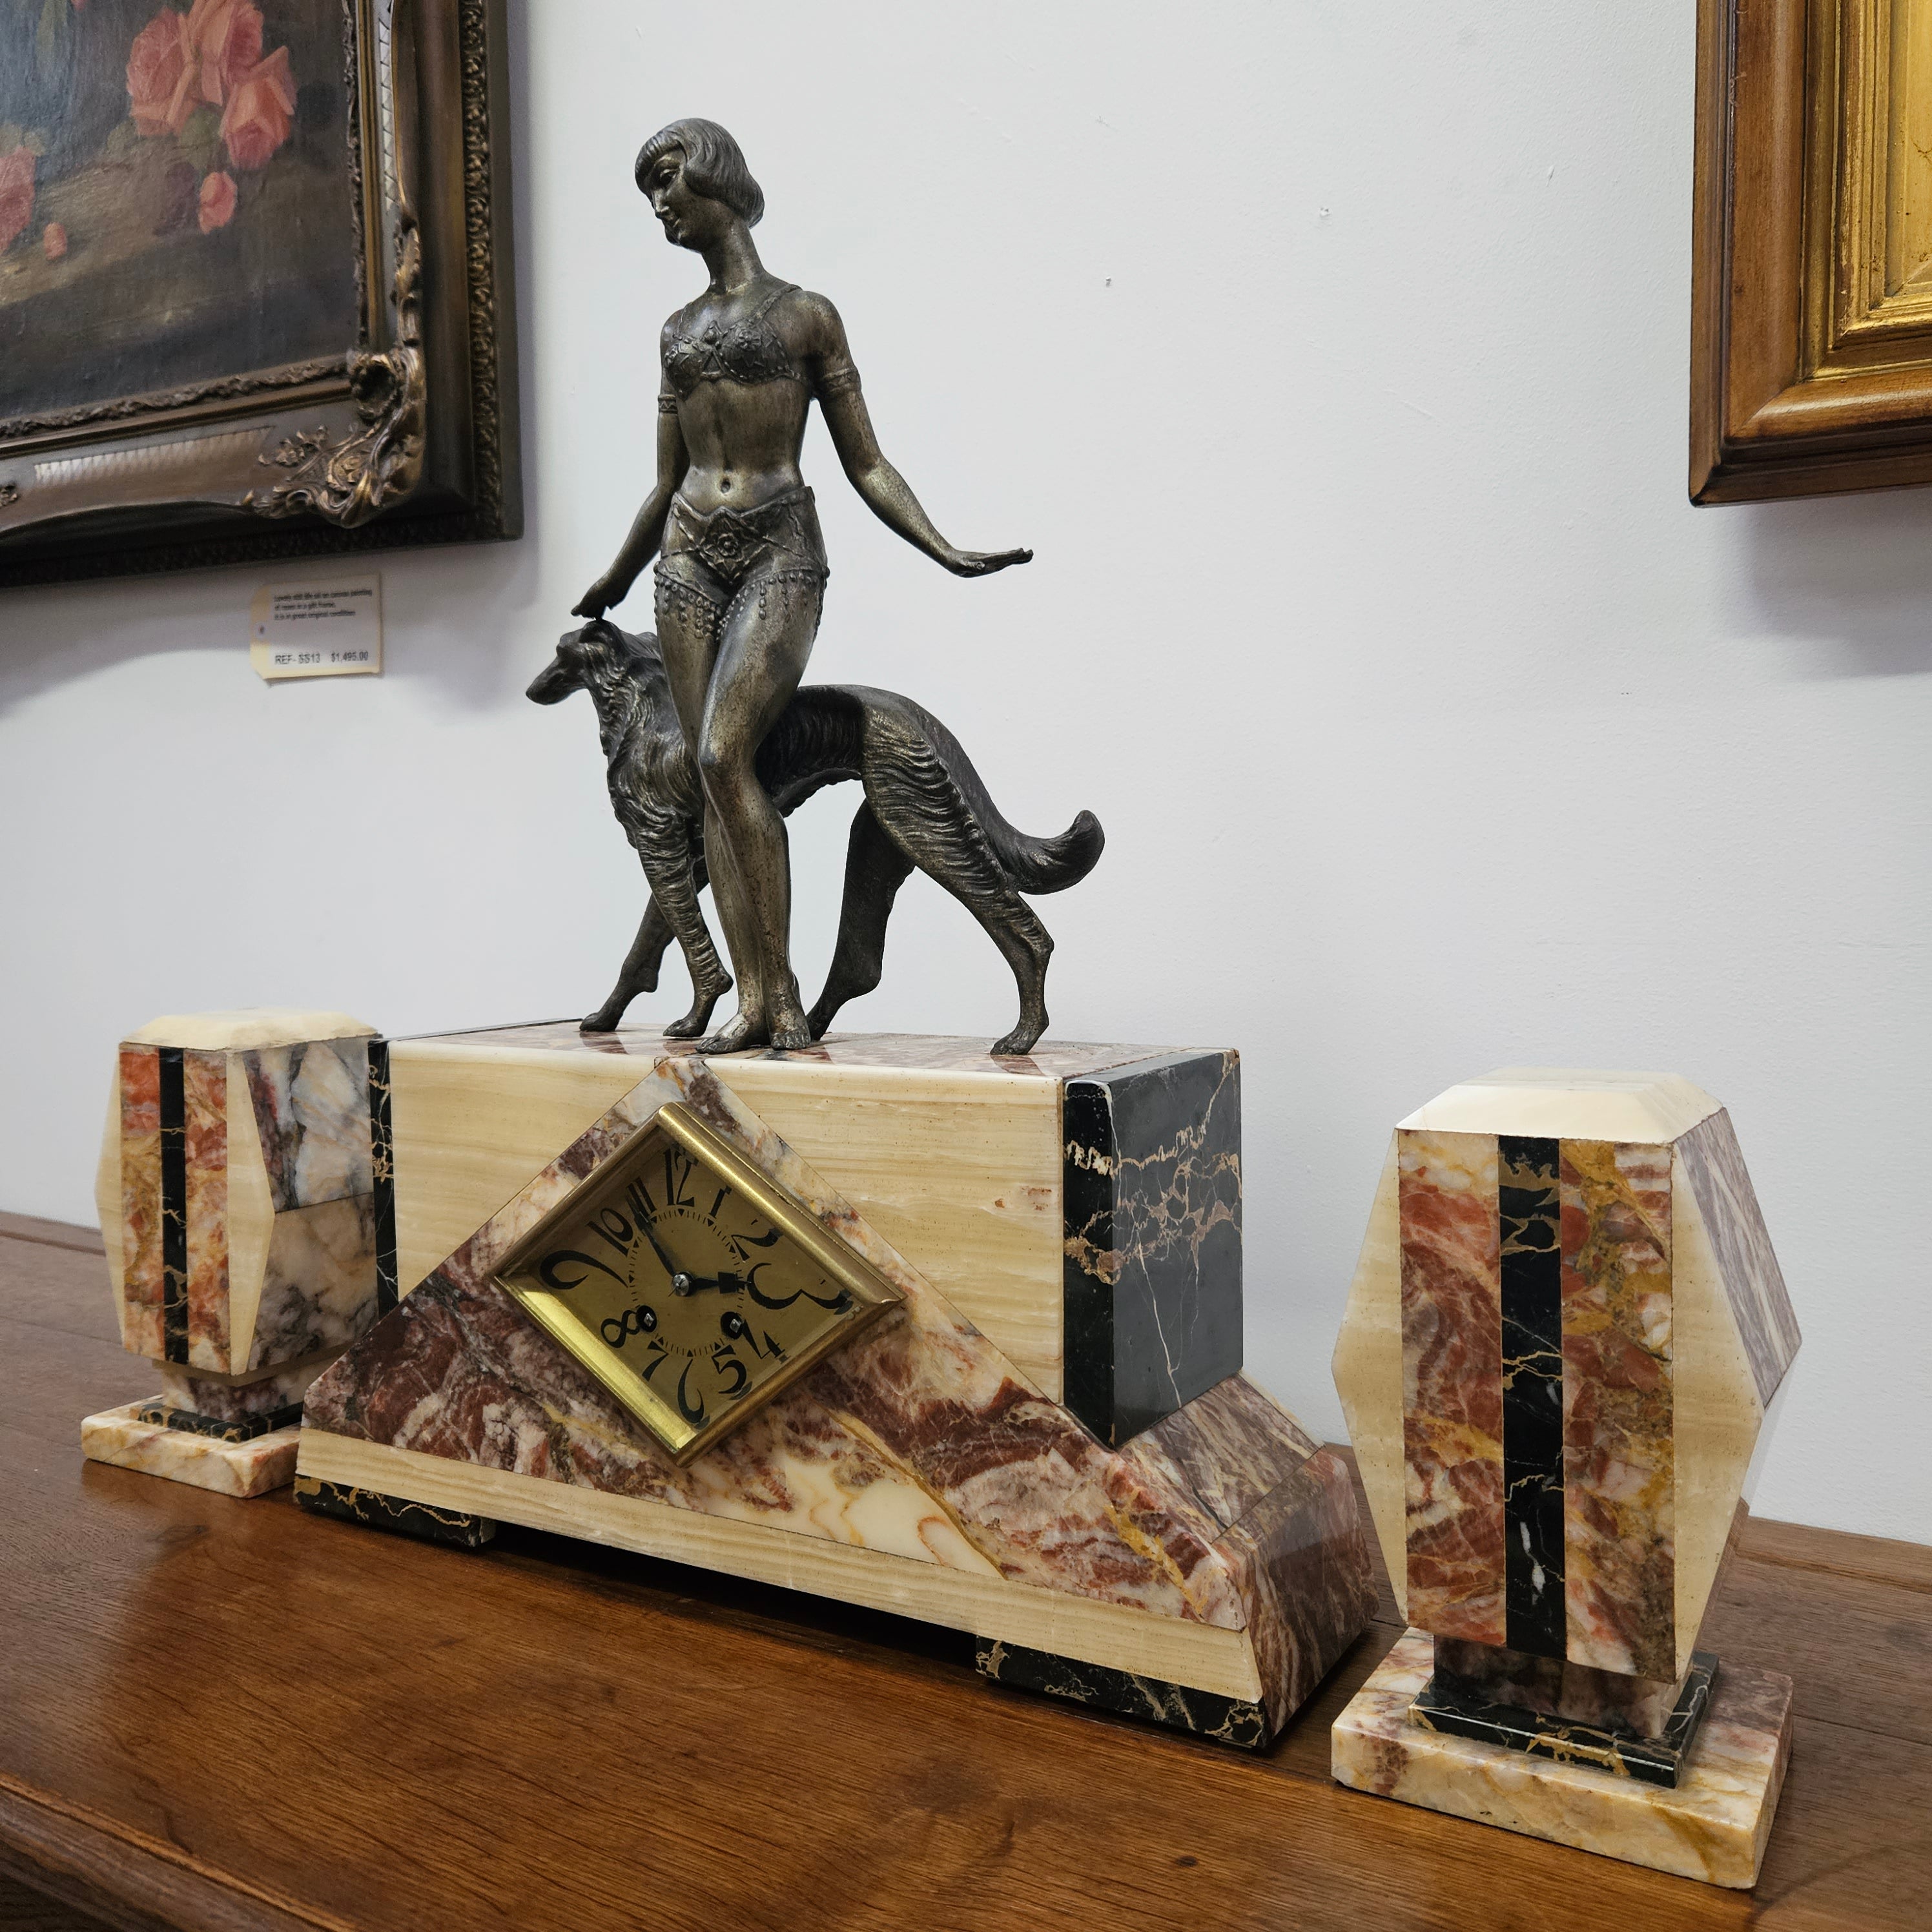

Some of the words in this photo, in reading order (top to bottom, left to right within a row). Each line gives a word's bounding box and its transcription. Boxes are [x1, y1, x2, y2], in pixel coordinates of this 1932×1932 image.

[331, 651, 369, 663] $1,495.00
[663, 1147, 699, 1207] 12
[709, 1186, 732, 1219] 1
[588, 1207, 634, 1256] 10
[732, 1218, 783, 1260] 2
[539, 1249, 629, 1290] 9
[746, 1262, 851, 1315] 3
[601, 1310, 641, 1348] 8
[741, 1319, 791, 1364] 4
[642, 1341, 670, 1381] 7
[711, 1344, 752, 1400] 5
[677, 1359, 710, 1428] 6
